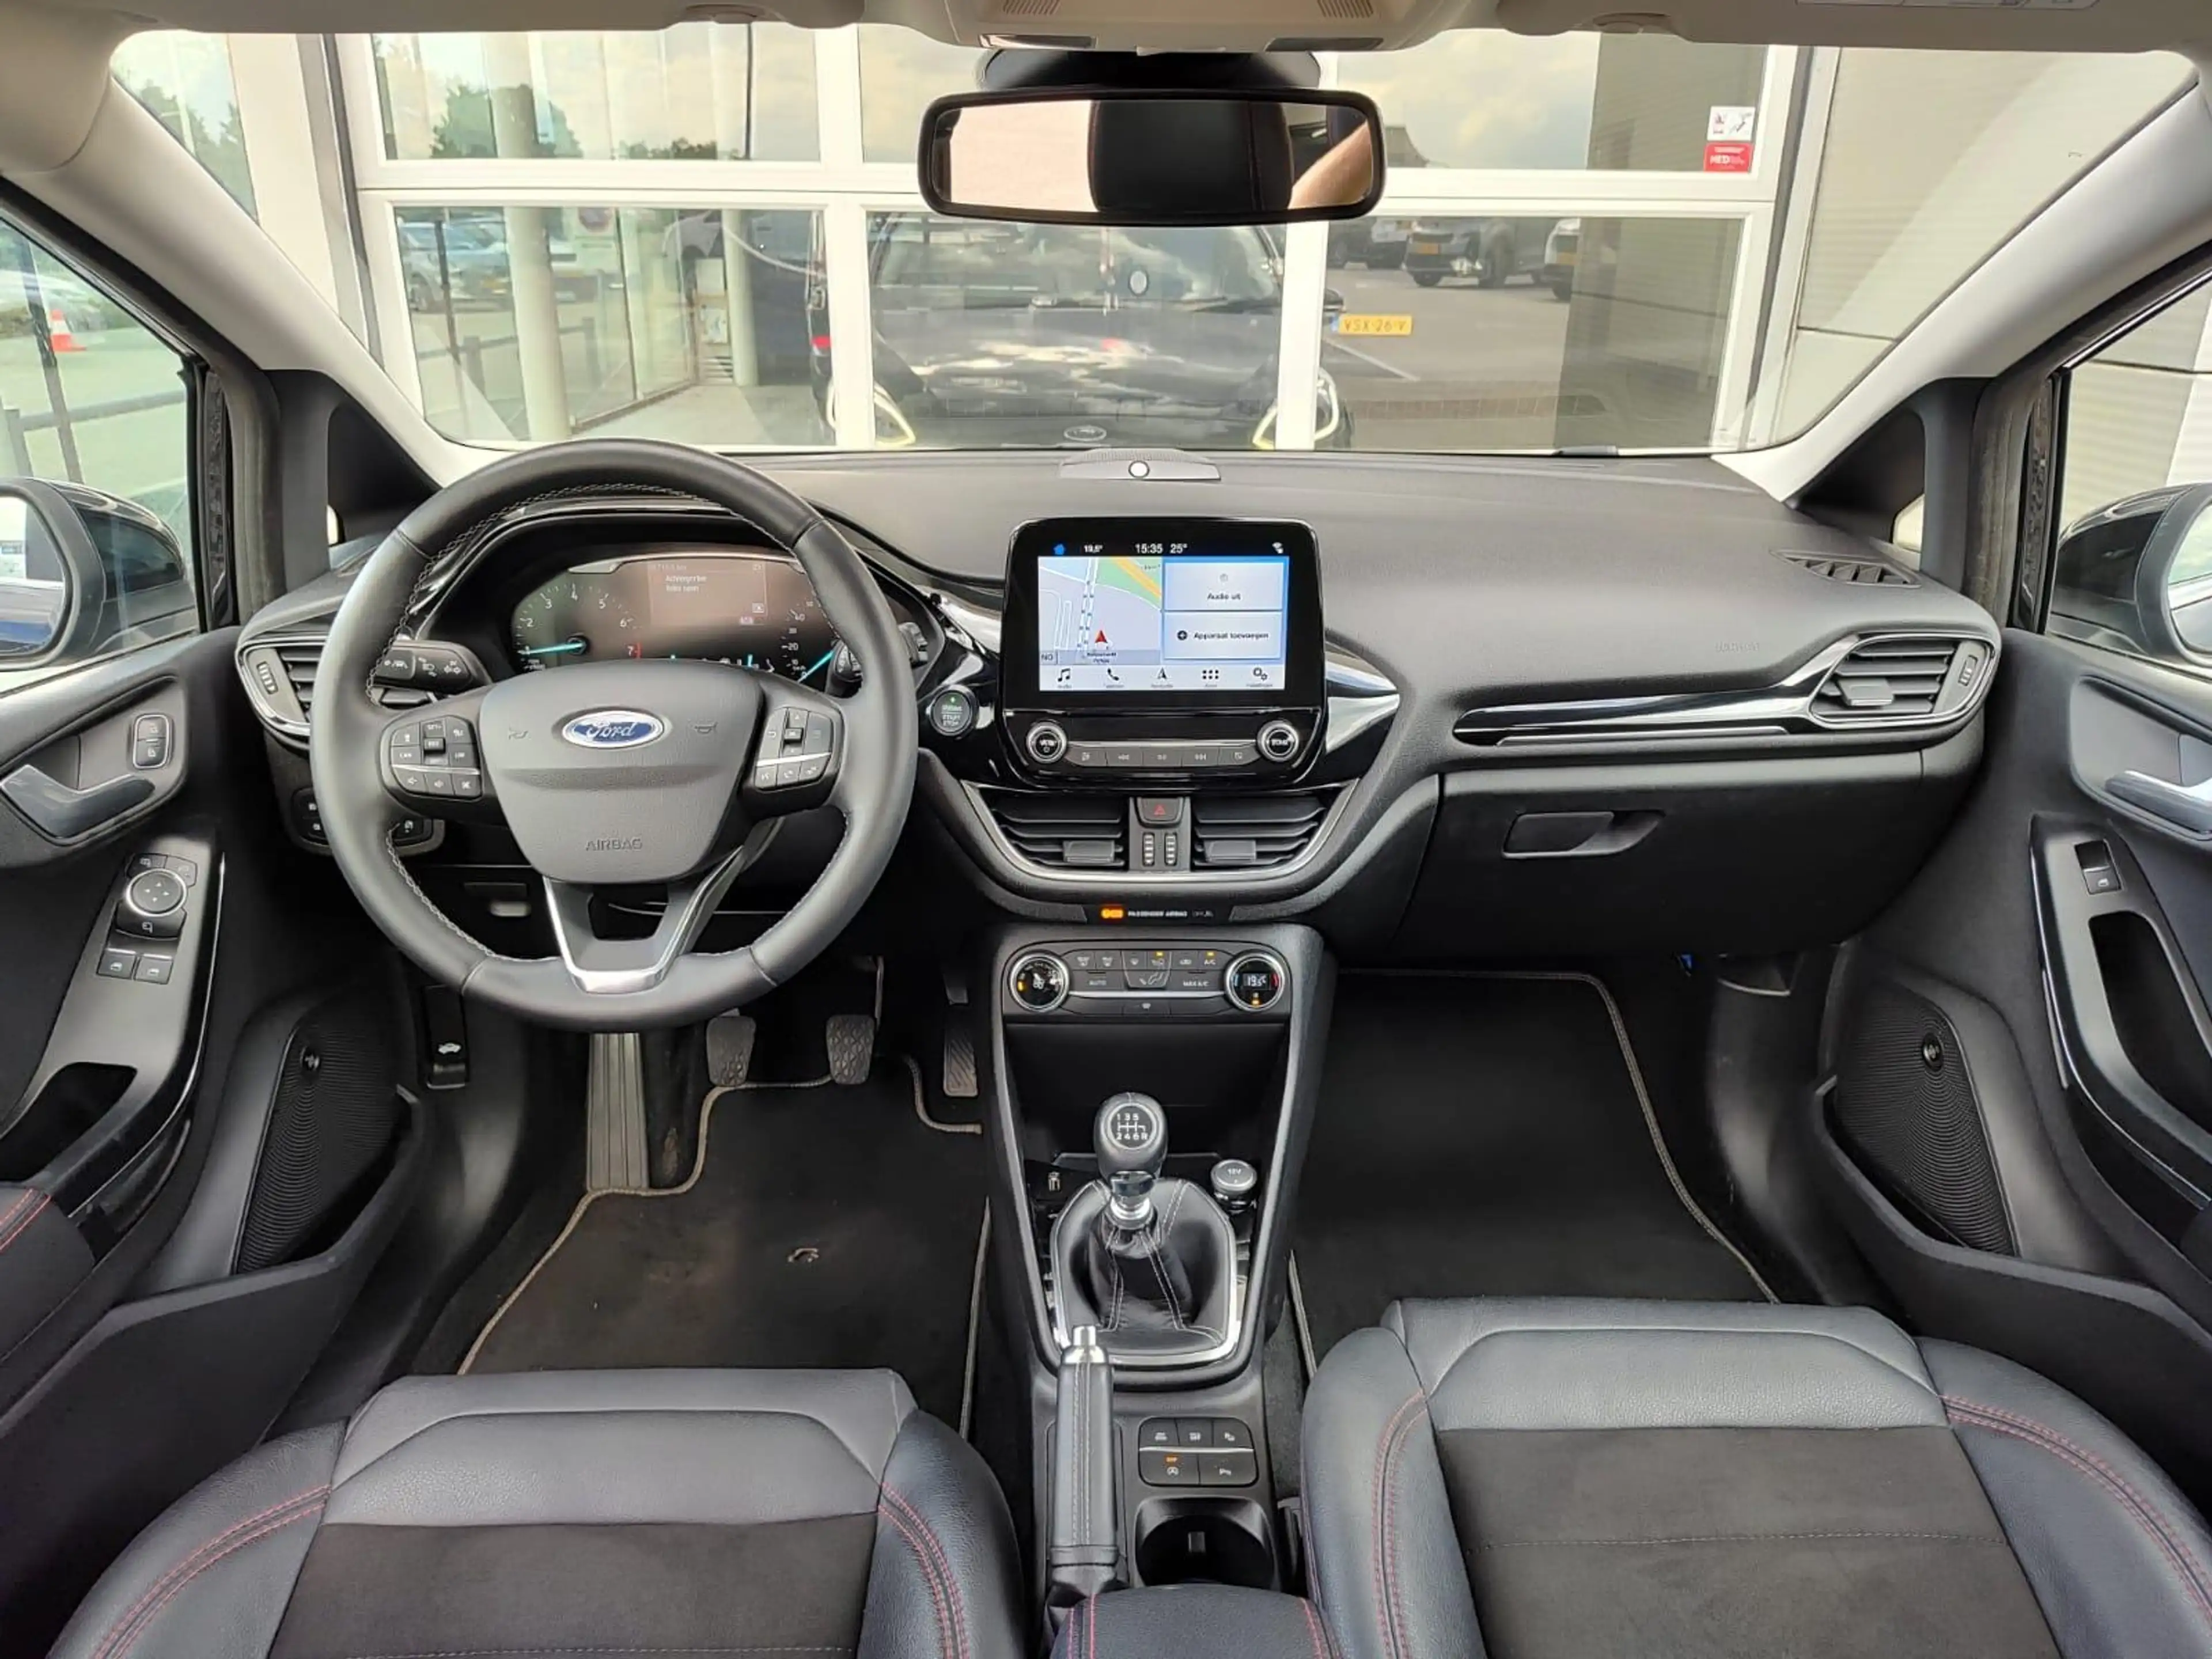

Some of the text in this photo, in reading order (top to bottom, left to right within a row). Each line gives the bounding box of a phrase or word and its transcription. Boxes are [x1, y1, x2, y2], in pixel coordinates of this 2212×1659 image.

[1135, 543, 1163, 554] 15:35
[545, 599, 552, 609] 3
[599, 599, 606, 609] 5
[527, 618, 533, 627] 2
[620, 618, 627, 627] 6
[627, 645, 634, 656] 7
[787, 642, 799, 651] 20
[586, 719, 637, 738] Ford
[585, 839, 643, 851] AIRBAG
[1116, 1132, 1122, 1140] 2
[1132, 1132, 1139, 1141] 6
